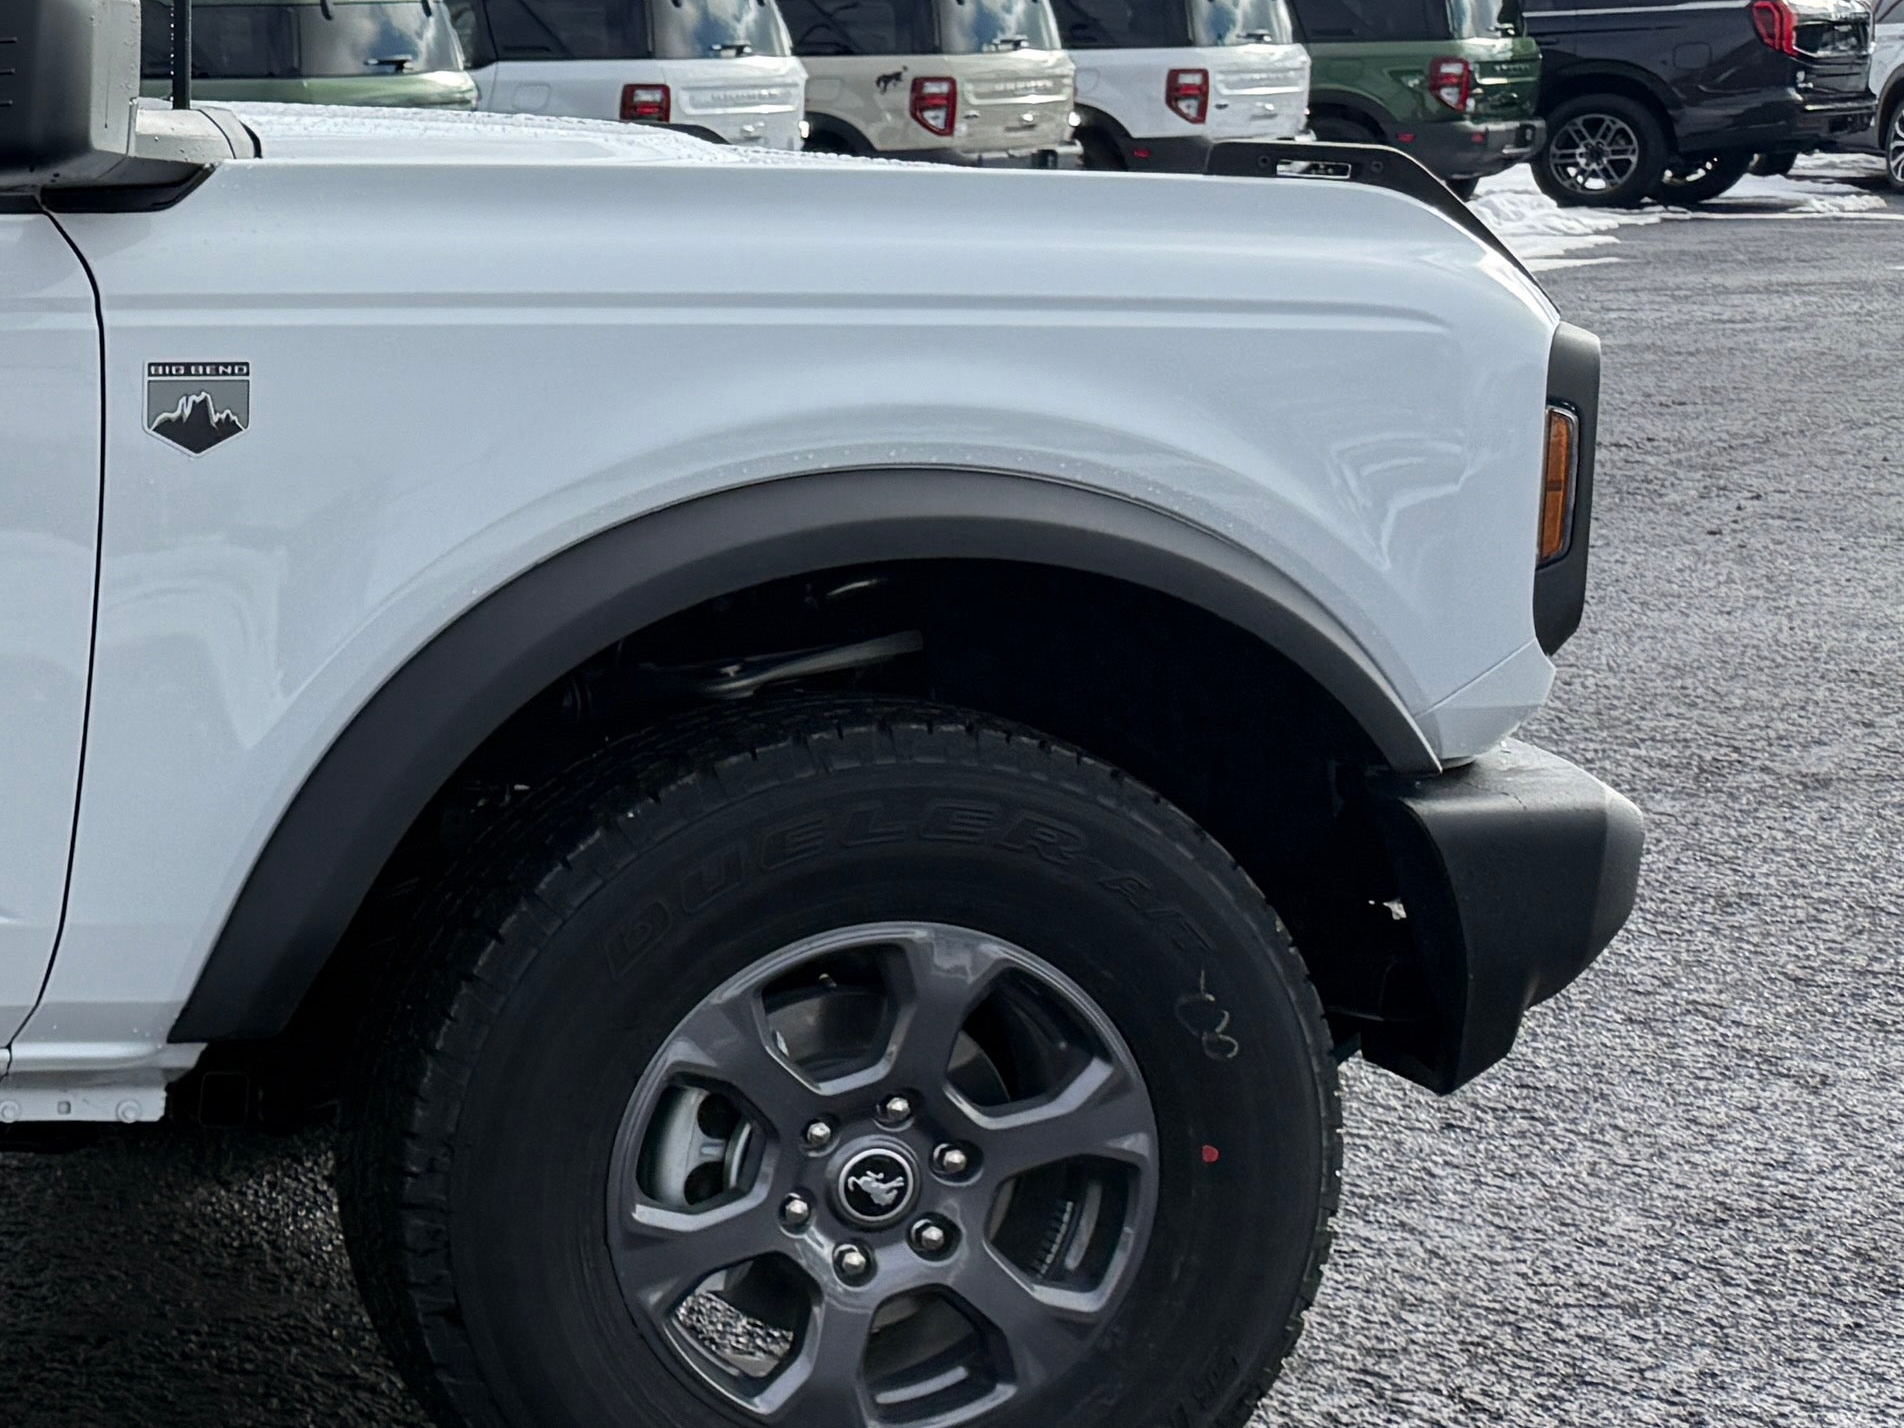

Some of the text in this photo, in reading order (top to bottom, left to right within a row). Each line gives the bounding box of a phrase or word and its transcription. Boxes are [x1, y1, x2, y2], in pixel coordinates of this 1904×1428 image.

[150, 364, 248, 375] BIG BEND
[602, 797, 1091, 980] DUELER
